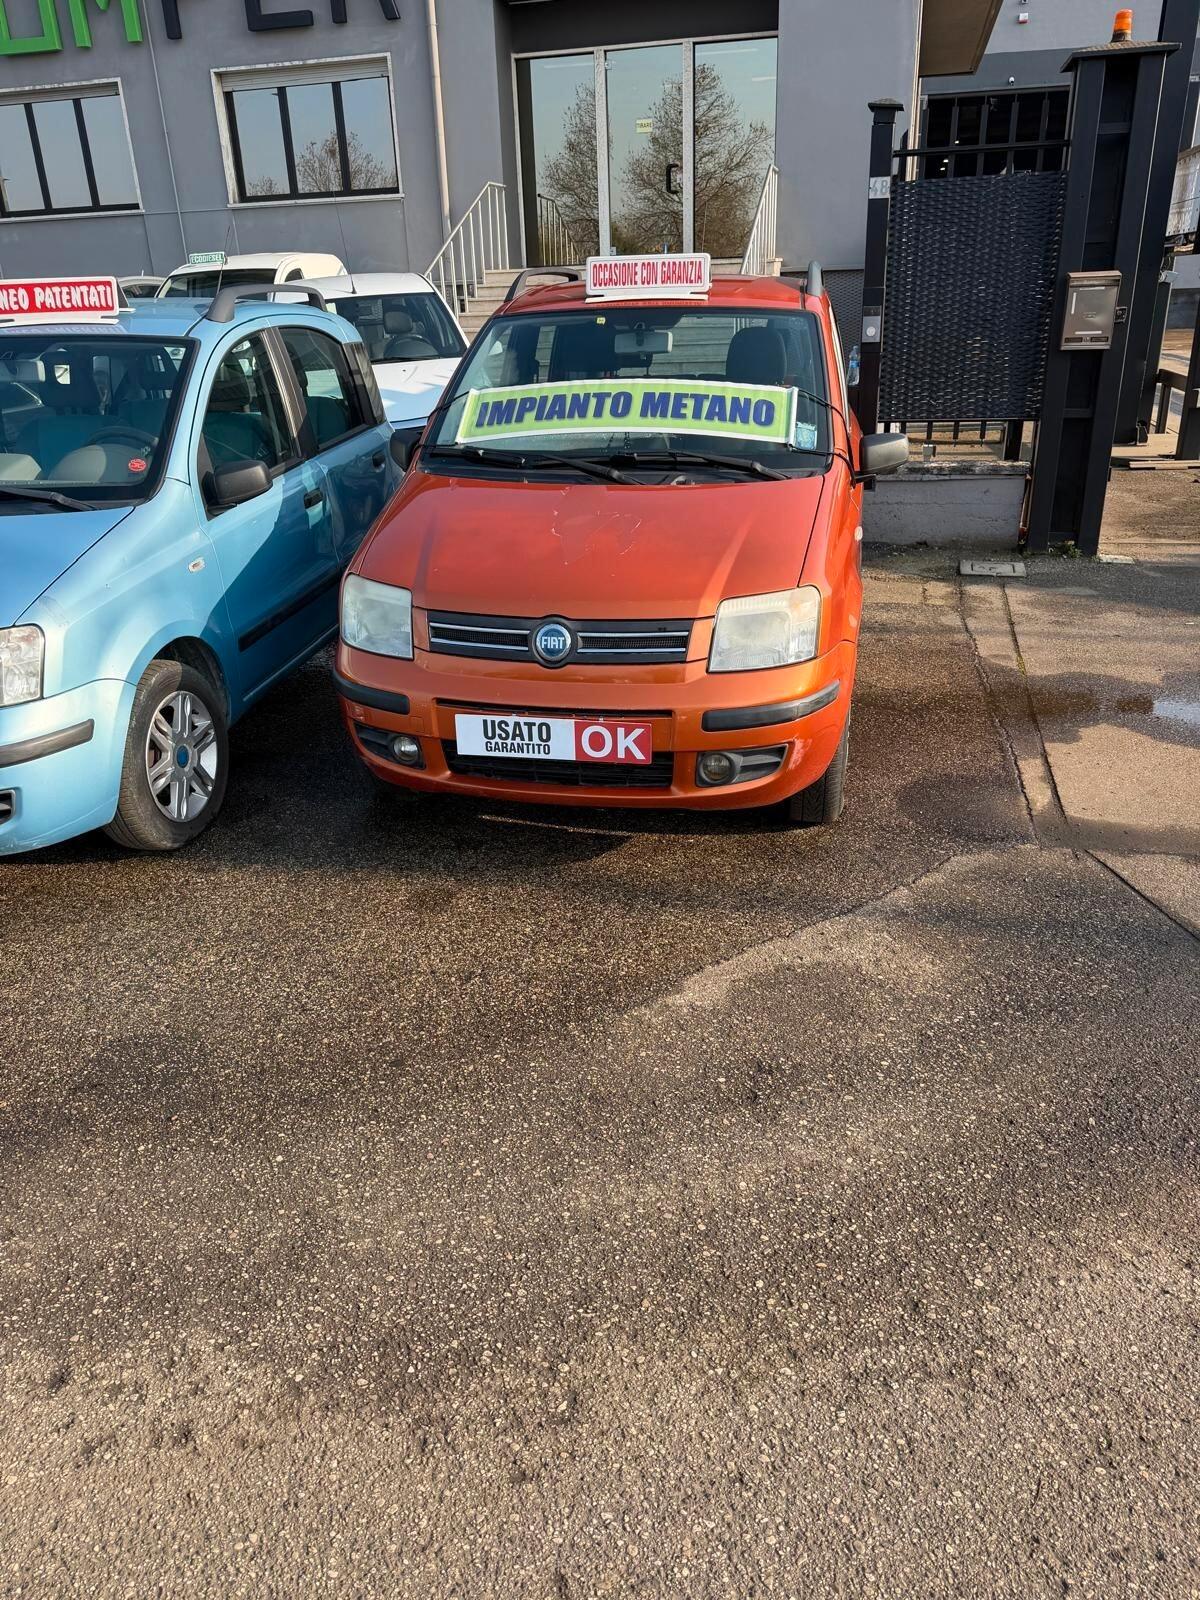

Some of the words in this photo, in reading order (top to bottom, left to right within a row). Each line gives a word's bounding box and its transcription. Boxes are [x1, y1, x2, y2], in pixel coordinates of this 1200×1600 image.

[870, 179, 889, 197] 48
[191, 253, 224, 264] ECODIESEL
[592, 262, 638, 288] OCCASIONE
[641, 261, 658, 286] CON
[661, 260, 703, 285] GARANZIA
[33, 285, 113, 309] PATENTATI
[475, 391, 633, 428] IMPIANTO
[639, 391, 776, 427] METANO
[541, 636, 565, 649] FIAT
[482, 719, 552, 743] USATO
[581, 725, 646, 760] OK
[485, 740, 551, 756] GARANTITO
